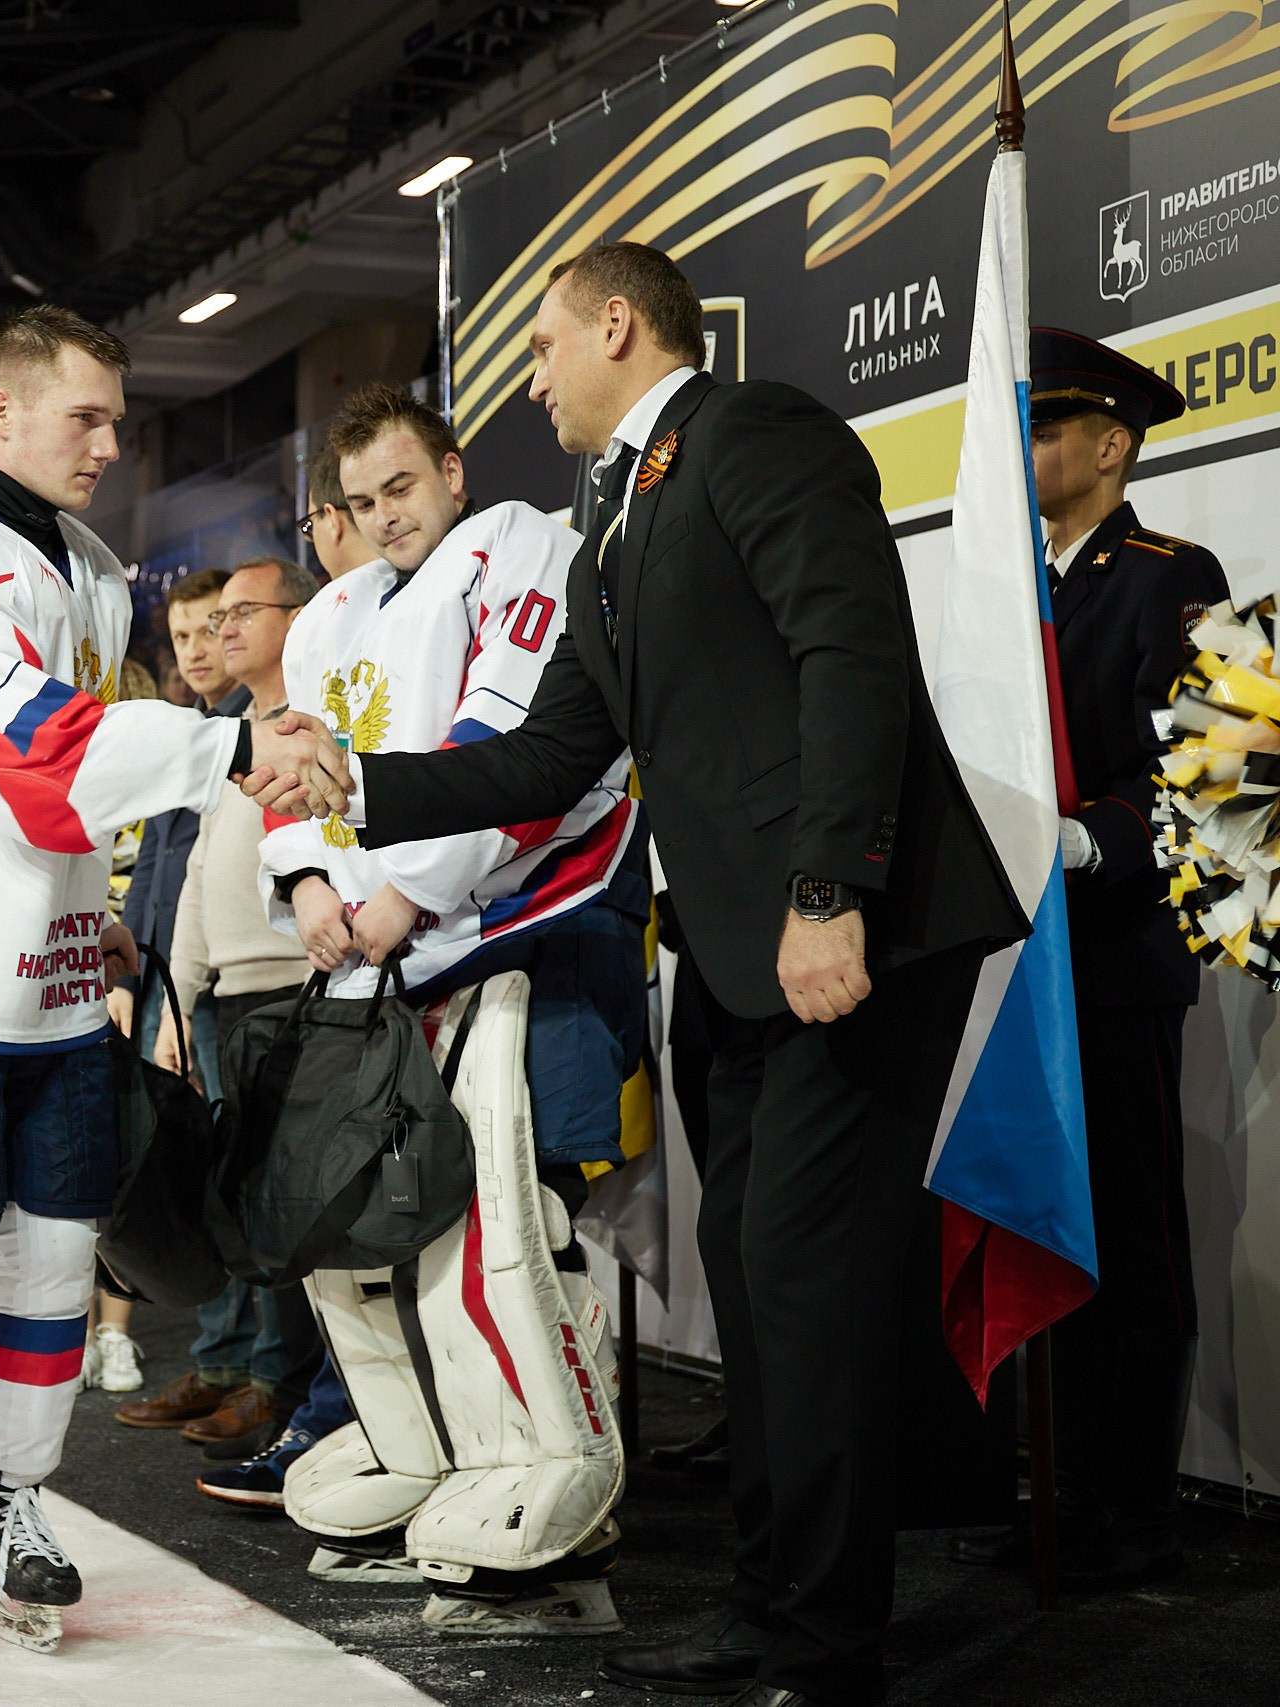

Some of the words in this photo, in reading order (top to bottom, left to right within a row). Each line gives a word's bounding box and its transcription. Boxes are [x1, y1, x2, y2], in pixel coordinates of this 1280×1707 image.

[1160, 158, 1280, 221] ПРАВИТЕЛЬ
[1160, 233, 1239, 276] ОБЛАСТИ
[844, 275, 946, 353] ЛИГА
[848, 332, 941, 385] СИЛЬНЫХ
[501, 588, 557, 654] 0
[1186, 617, 1201, 631] РОС
